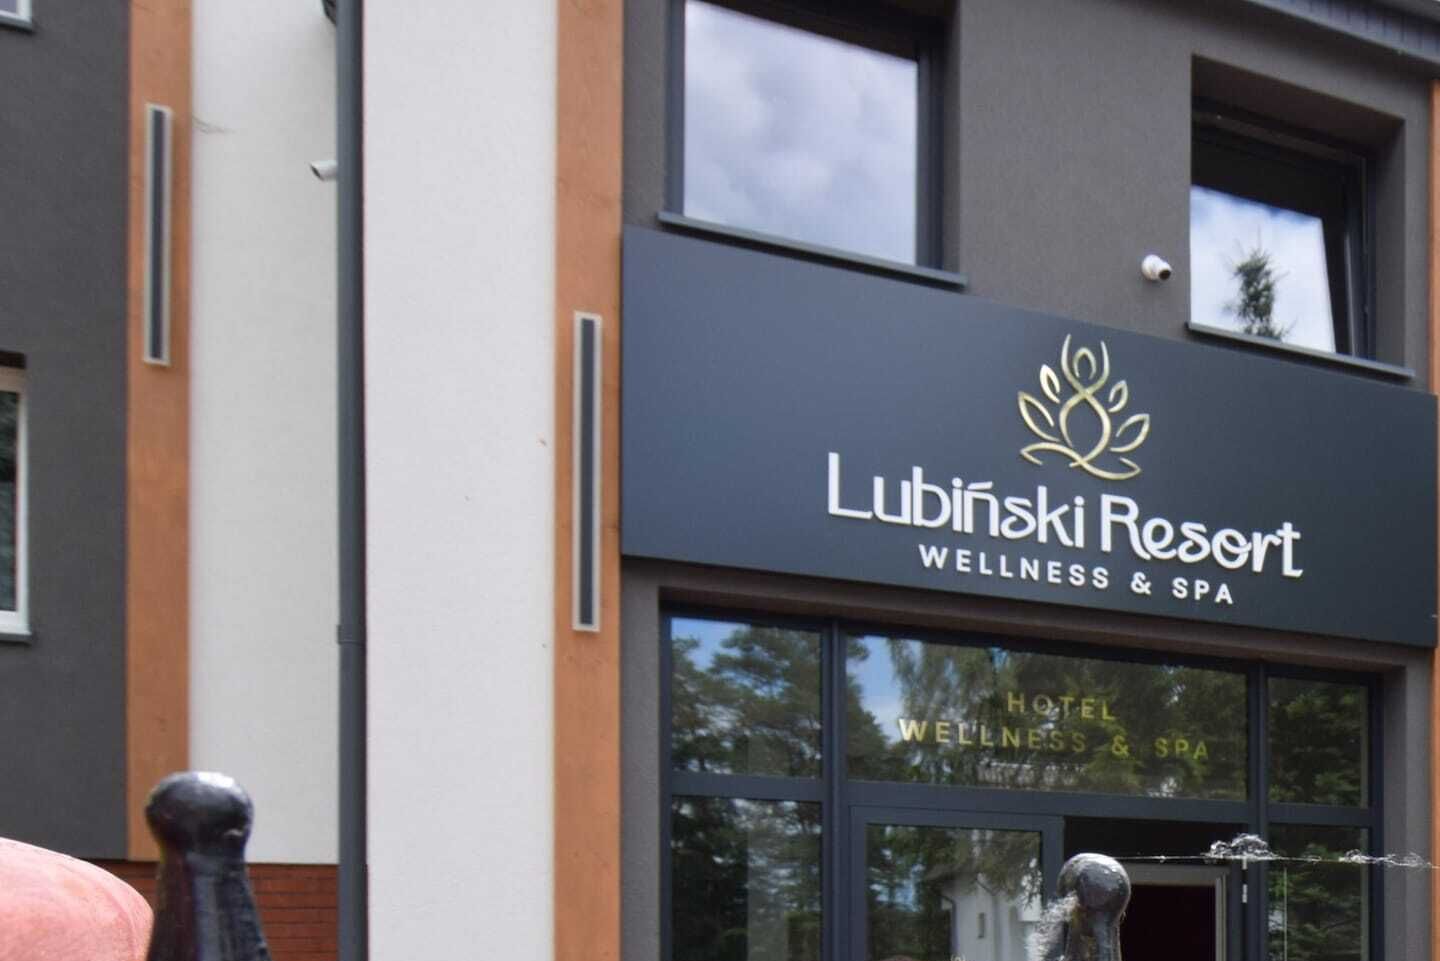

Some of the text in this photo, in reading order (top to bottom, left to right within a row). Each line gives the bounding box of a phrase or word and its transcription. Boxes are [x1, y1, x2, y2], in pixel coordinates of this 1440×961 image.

[828, 452, 1303, 577] Lubiński Resort
[918, 544, 1233, 605] WELLNESS & SPA
[1006, 691, 1115, 721] HOTEL
[899, 718, 1208, 761] WELLNESS & SPA
